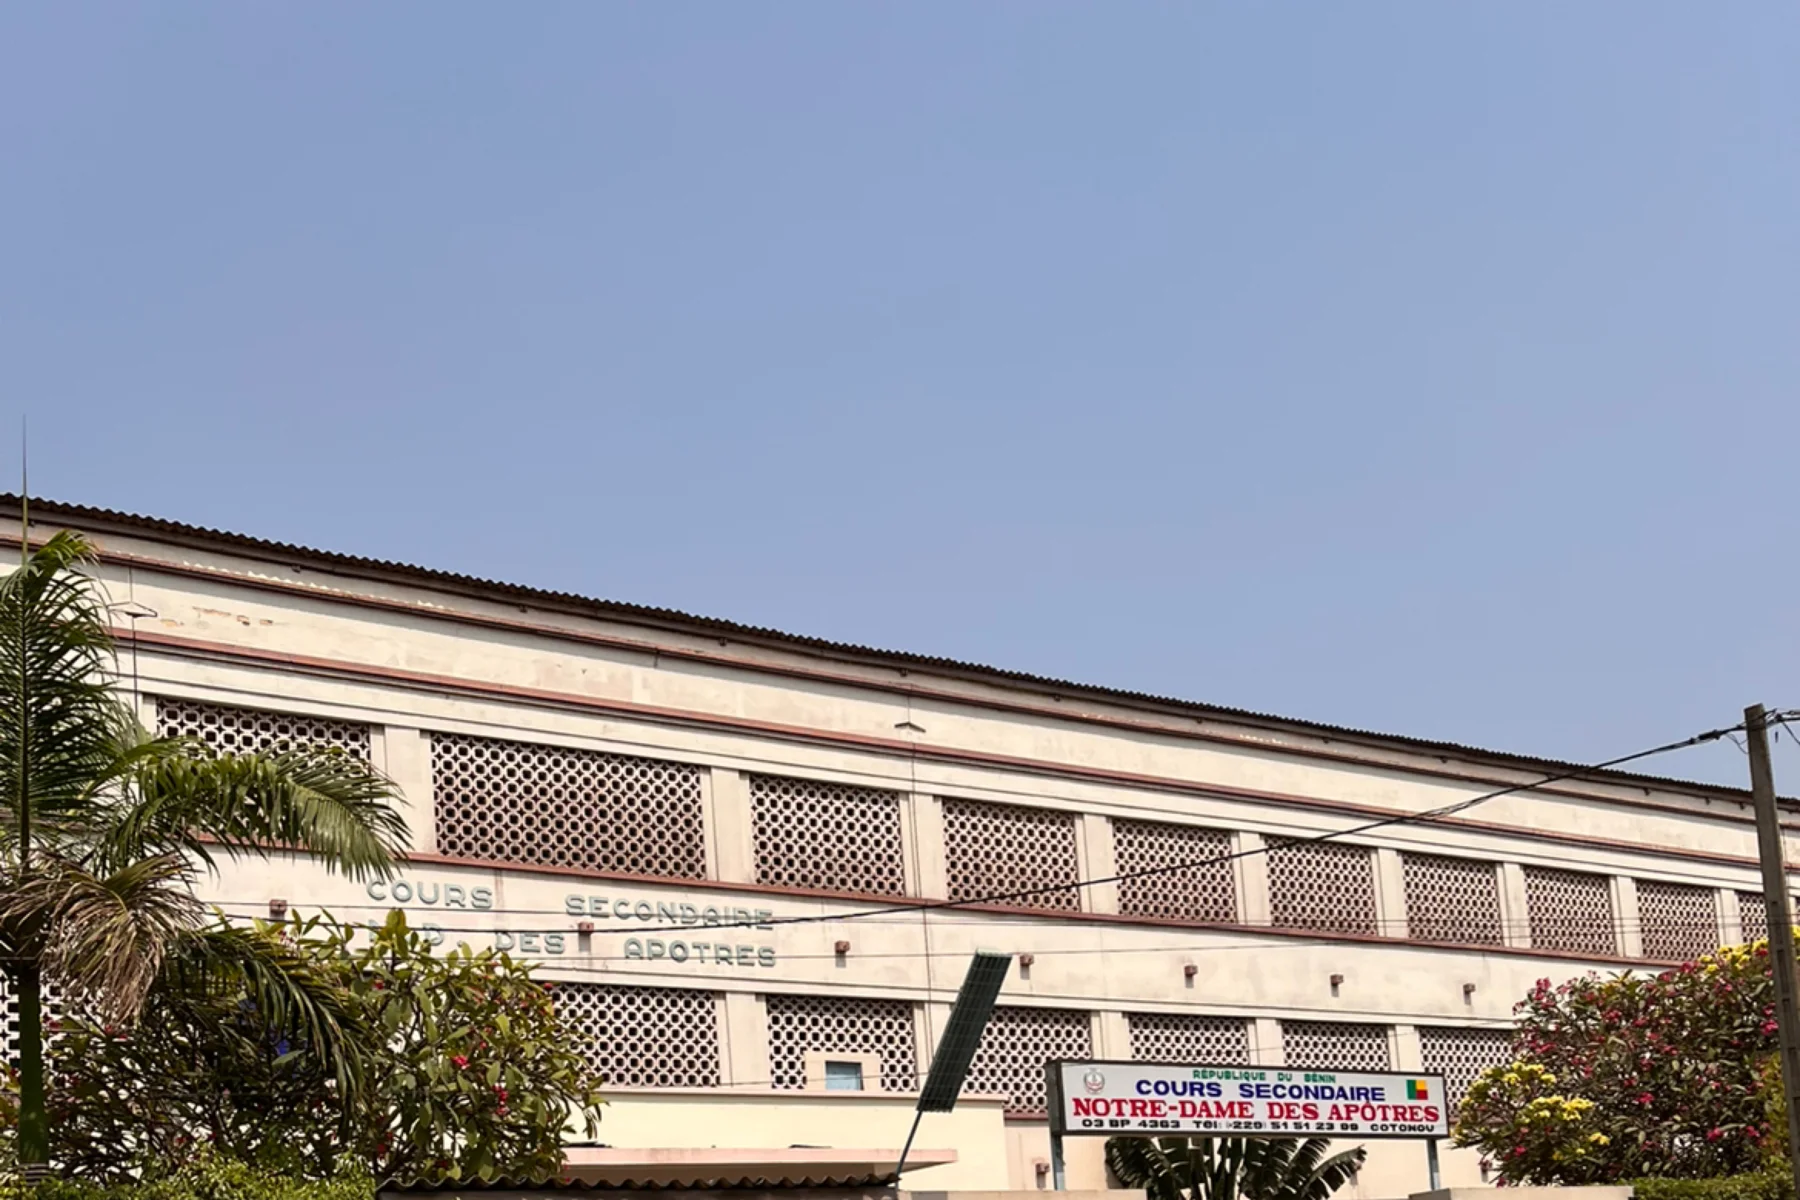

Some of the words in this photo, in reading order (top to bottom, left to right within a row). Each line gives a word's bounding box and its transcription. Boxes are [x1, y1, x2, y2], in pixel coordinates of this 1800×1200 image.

[366, 880, 493, 908] COURS
[565, 894, 774, 931] SECONDAIRE
[496, 931, 565, 954] DES
[624, 938, 776, 967] APOTRES
[1193, 1069, 1266, 1080] RÉPUBLIQUE
[1278, 1072, 1293, 1082] DU
[1304, 1072, 1336, 1083] BÉNIN
[1136, 1080, 1222, 1096] COURS
[1239, 1083, 1386, 1101] SECONDAIRE
[1072, 1098, 1255, 1119] NOTRE-DAME
[1267, 1102, 1320, 1120] DES
[1327, 1101, 1440, 1122] APÔTRES
[1081, 1119, 1104, 1128] 03
[1109, 1119, 1131, 1128] BP
[1370, 1123, 1435, 1133] COTONOU
